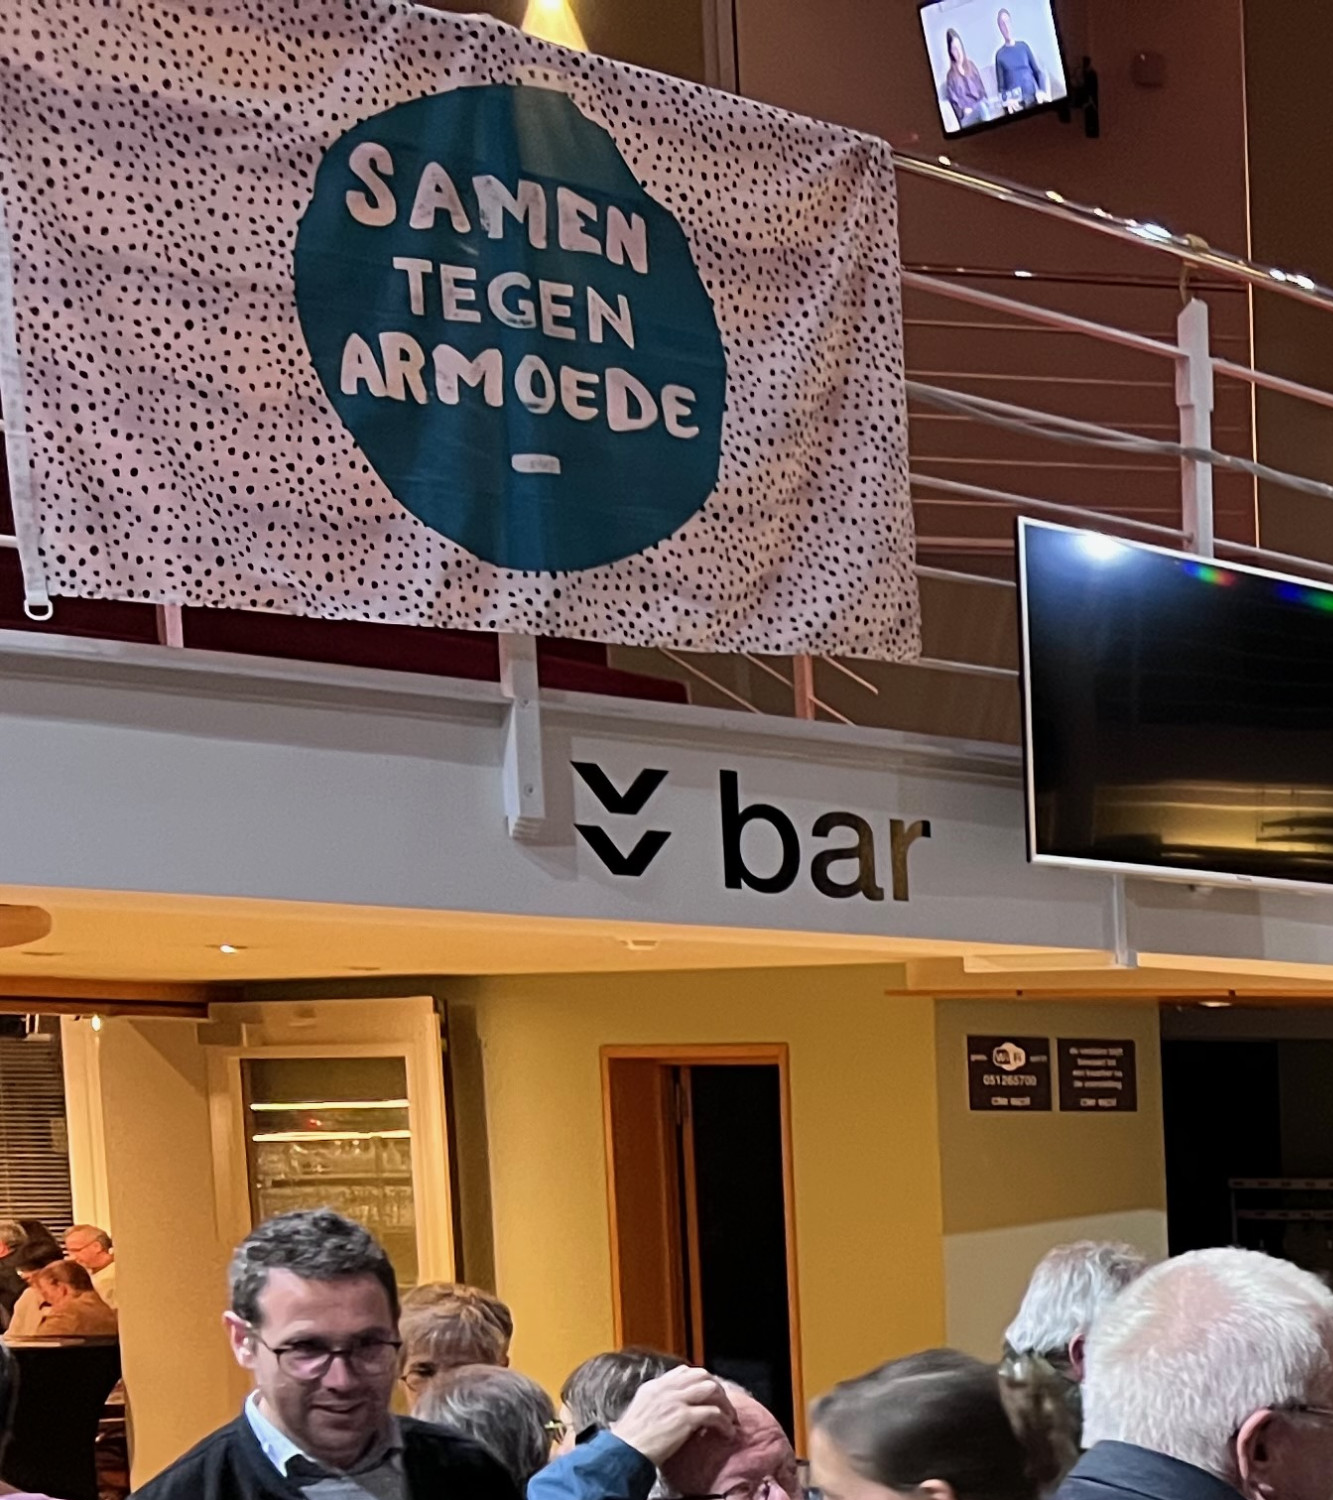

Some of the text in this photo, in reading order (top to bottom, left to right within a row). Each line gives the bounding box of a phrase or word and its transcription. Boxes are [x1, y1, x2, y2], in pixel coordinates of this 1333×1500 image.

[346, 142, 649, 274] SAMEN
[392, 256, 635, 350] TEGEN
[340, 332, 700, 439] ARMOEDE
[719, 769, 932, 902] bar
